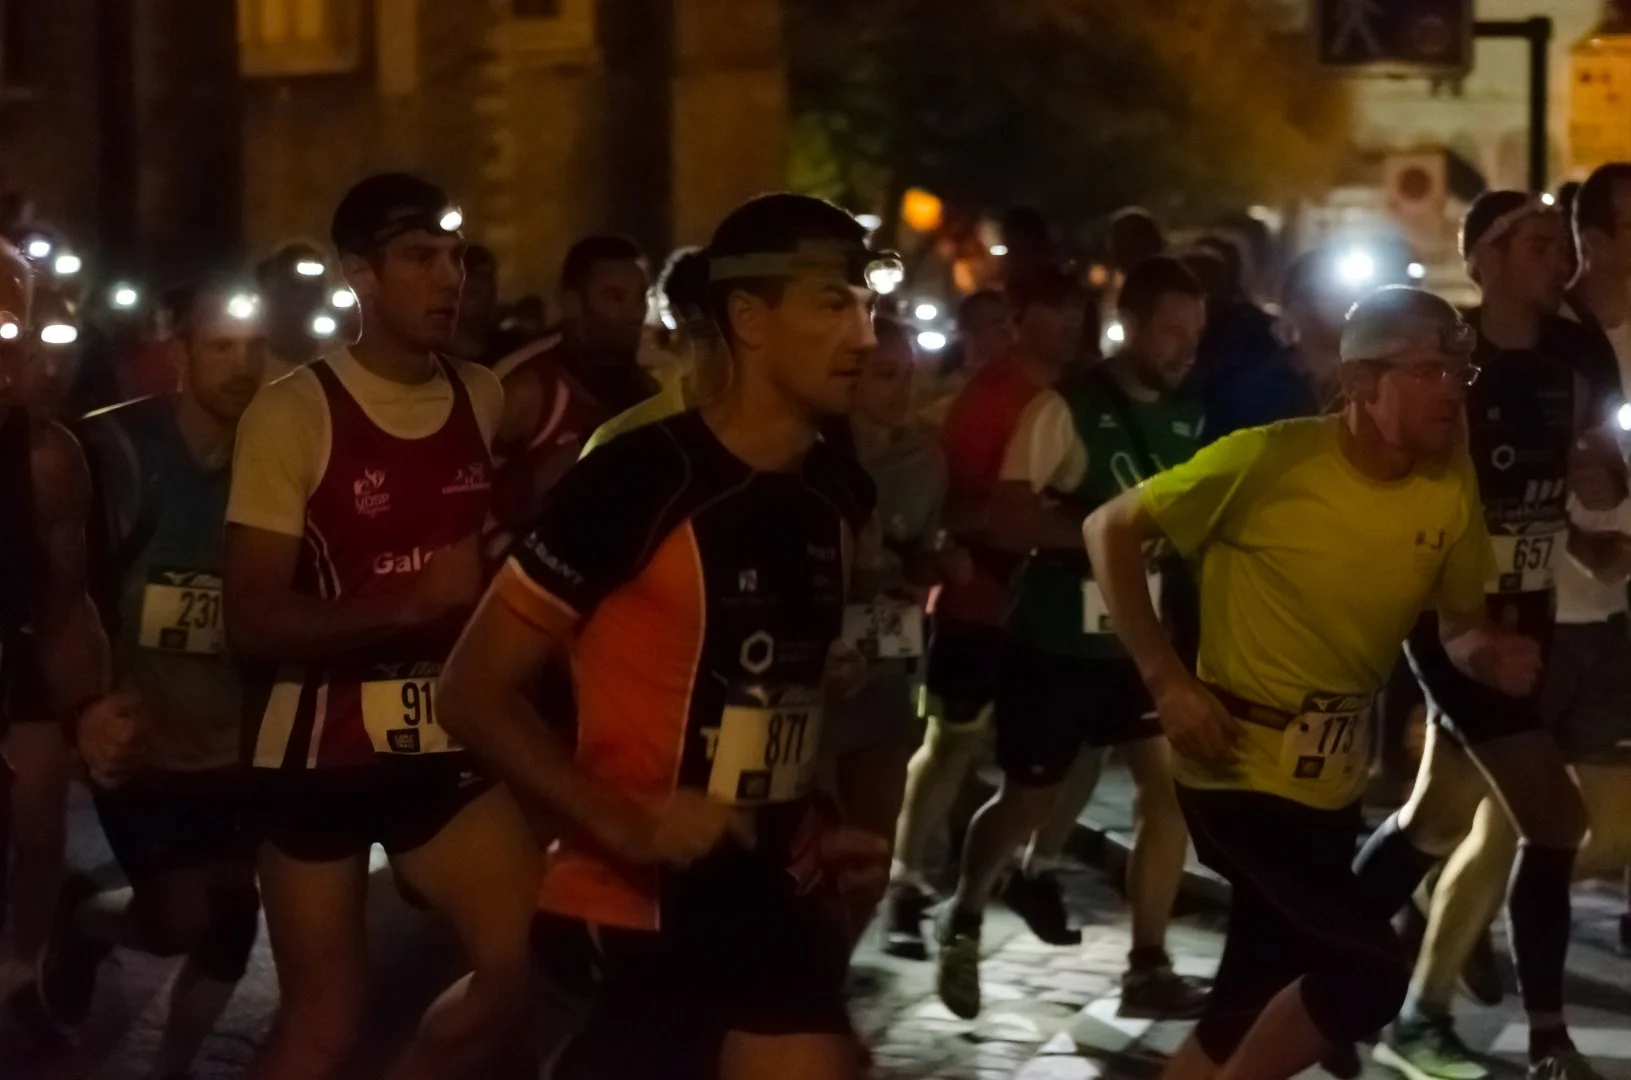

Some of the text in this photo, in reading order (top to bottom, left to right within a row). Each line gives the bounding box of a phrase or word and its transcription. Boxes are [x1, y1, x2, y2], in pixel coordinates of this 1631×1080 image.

[1513, 537, 1554, 570] 657
[177, 592, 219, 629] 231
[402, 682, 433, 726] 91
